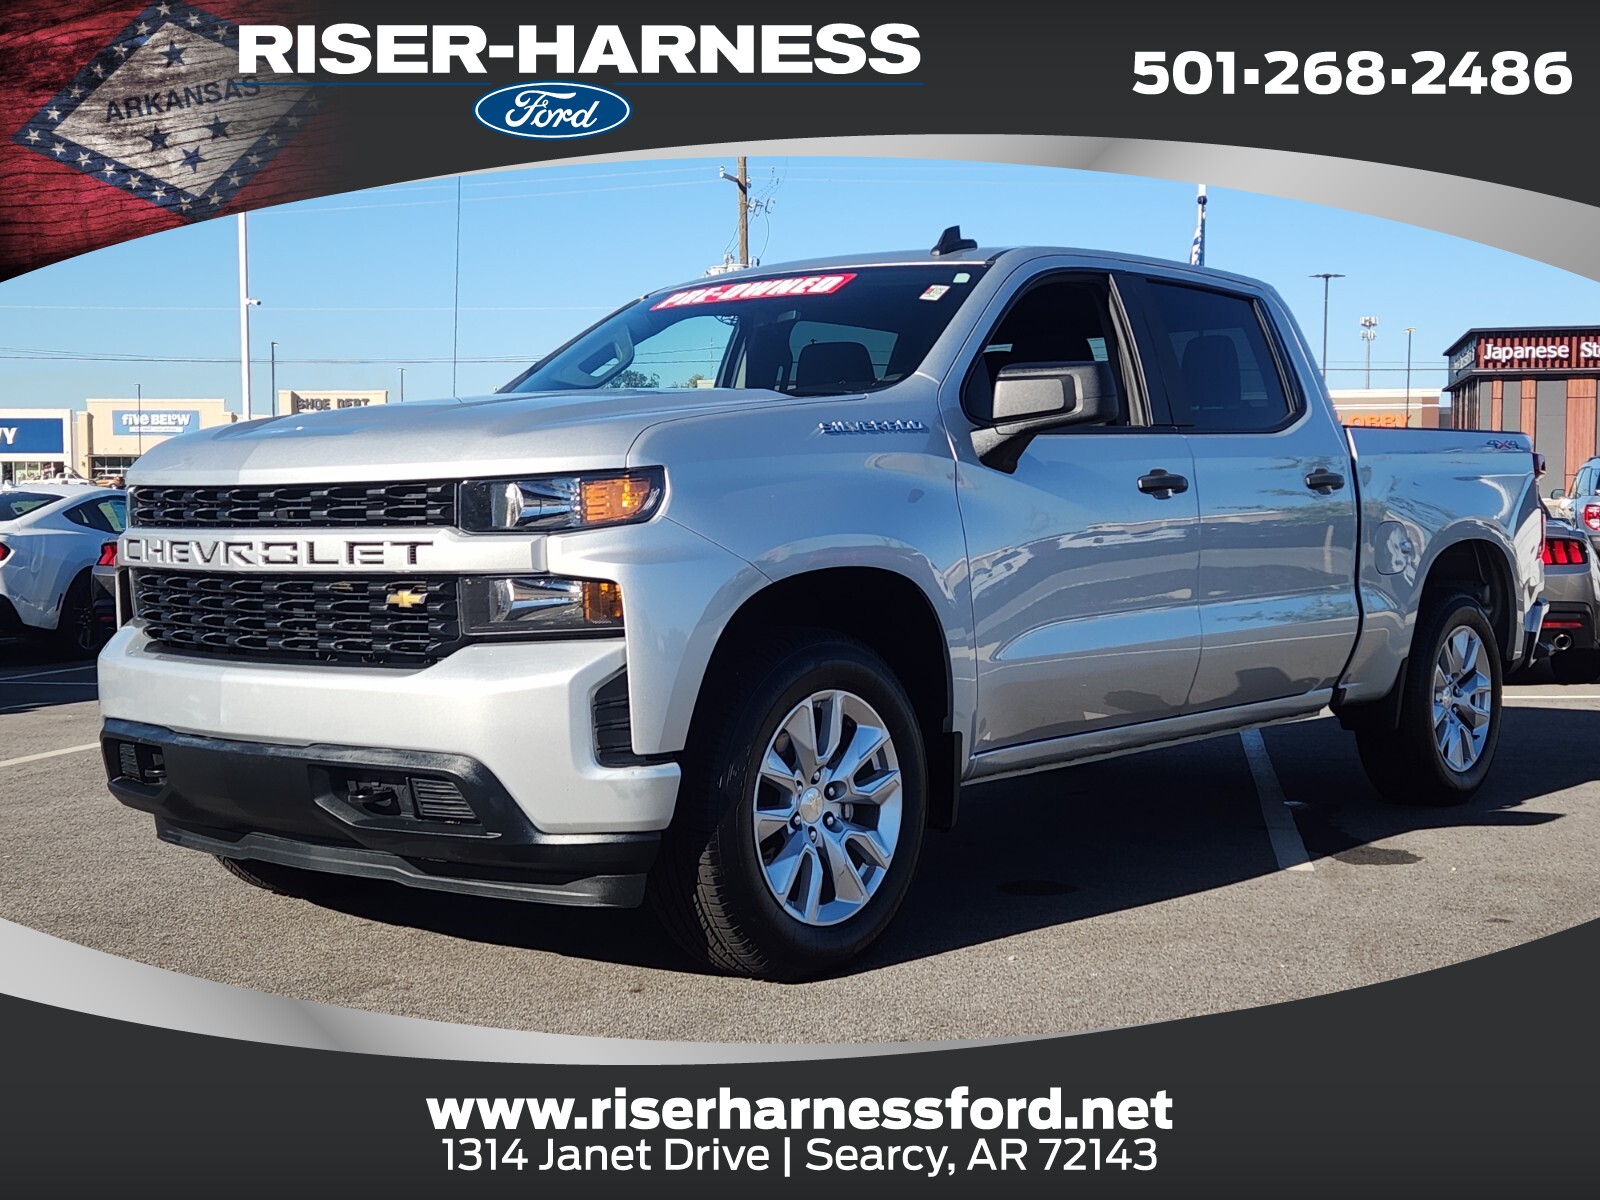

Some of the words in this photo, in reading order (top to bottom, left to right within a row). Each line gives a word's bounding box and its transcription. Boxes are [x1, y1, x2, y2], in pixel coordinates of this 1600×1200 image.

[655, 275, 845, 308] PRE-OWNED
[1484, 343, 1570, 363] Japanese
[1580, 341, 1600, 358] St
[297, 398, 331, 411] SHOE
[122, 414, 150, 426] five
[123, 538, 434, 566] CHEVROLET
